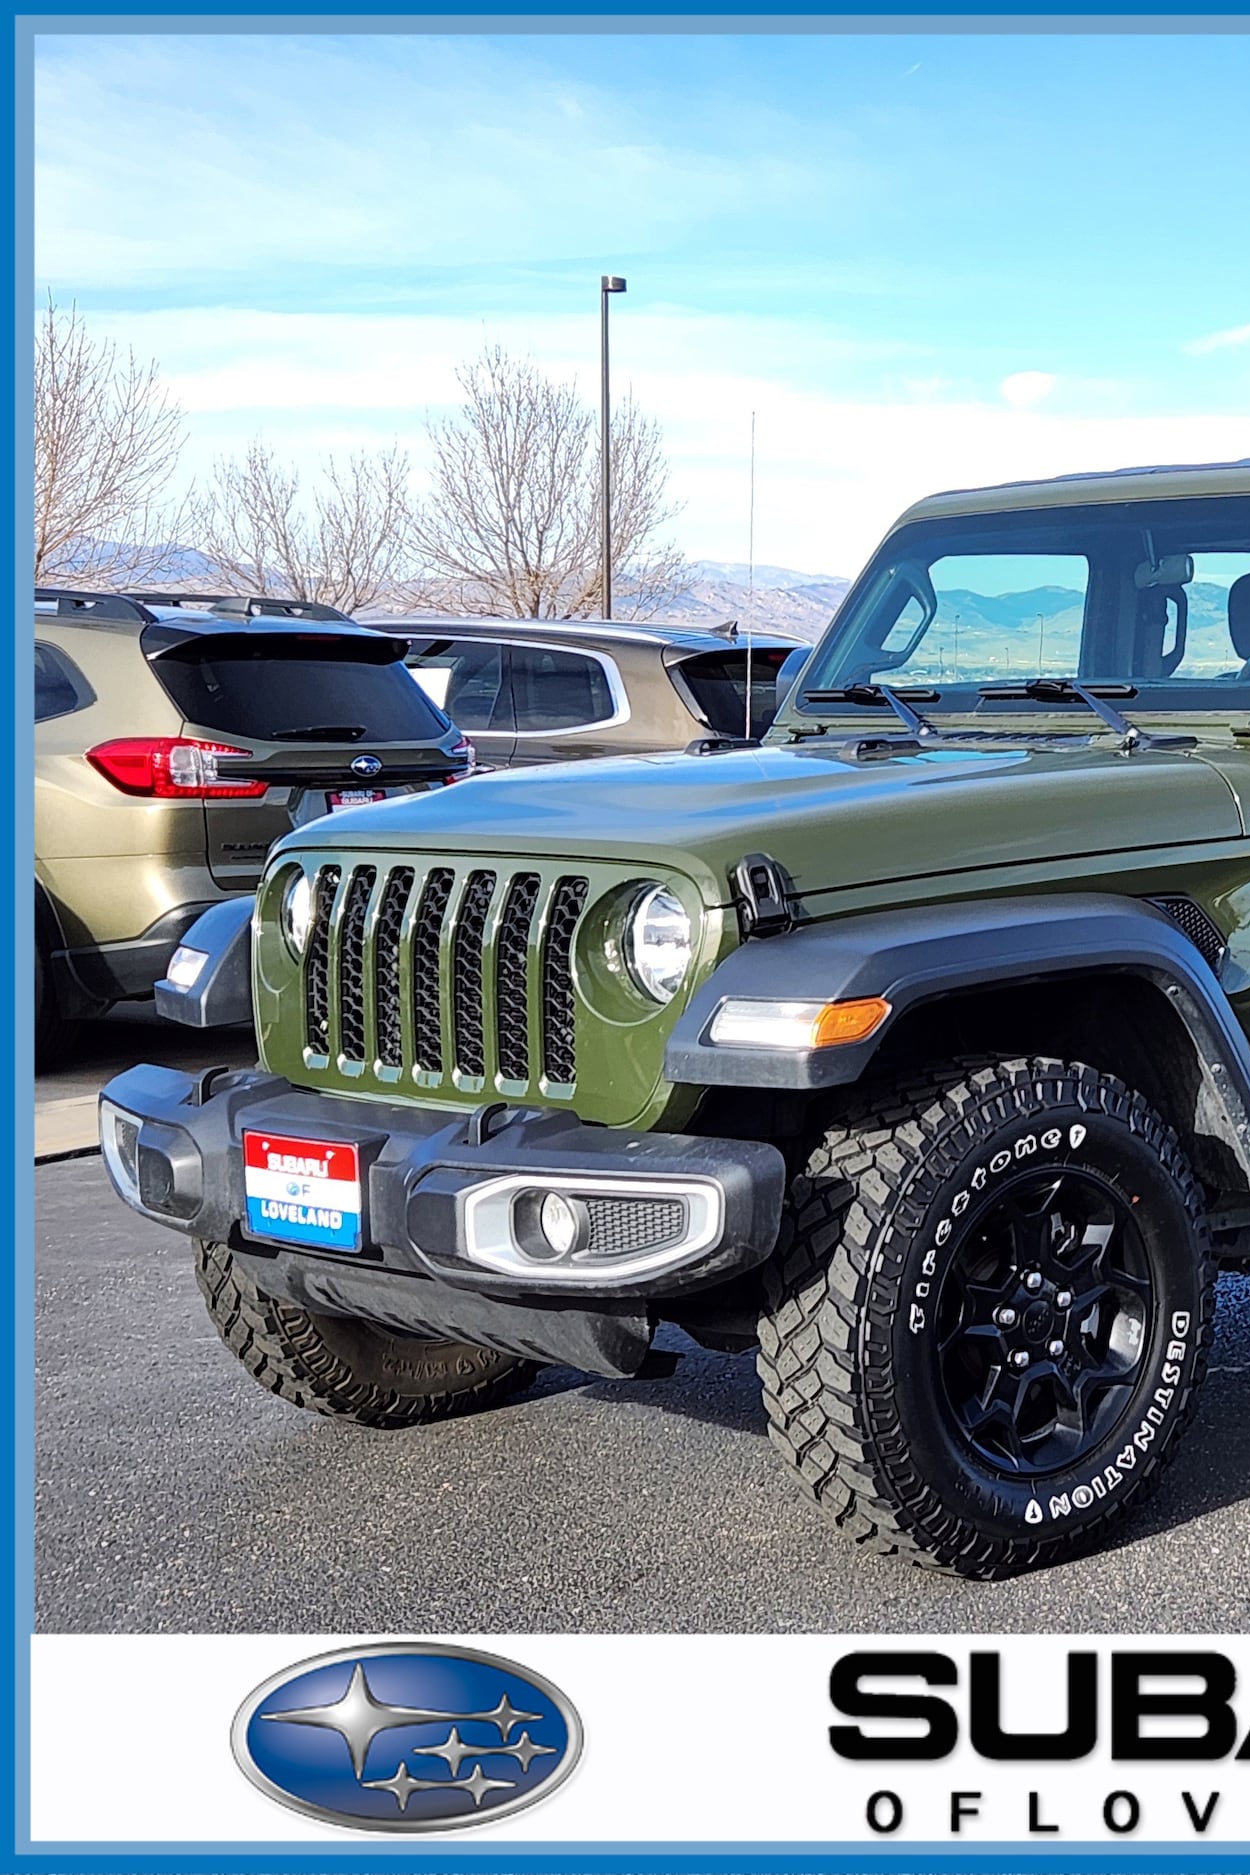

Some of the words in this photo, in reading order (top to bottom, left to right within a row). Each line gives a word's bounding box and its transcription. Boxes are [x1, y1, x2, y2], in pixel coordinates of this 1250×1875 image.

[261, 1199, 344, 1231] LOVELAND
[267, 1152, 329, 1178] SUBARU
[908, 1126, 1064, 1335] Firestone
[1048, 1309, 1191, 1520] DESTINATION
